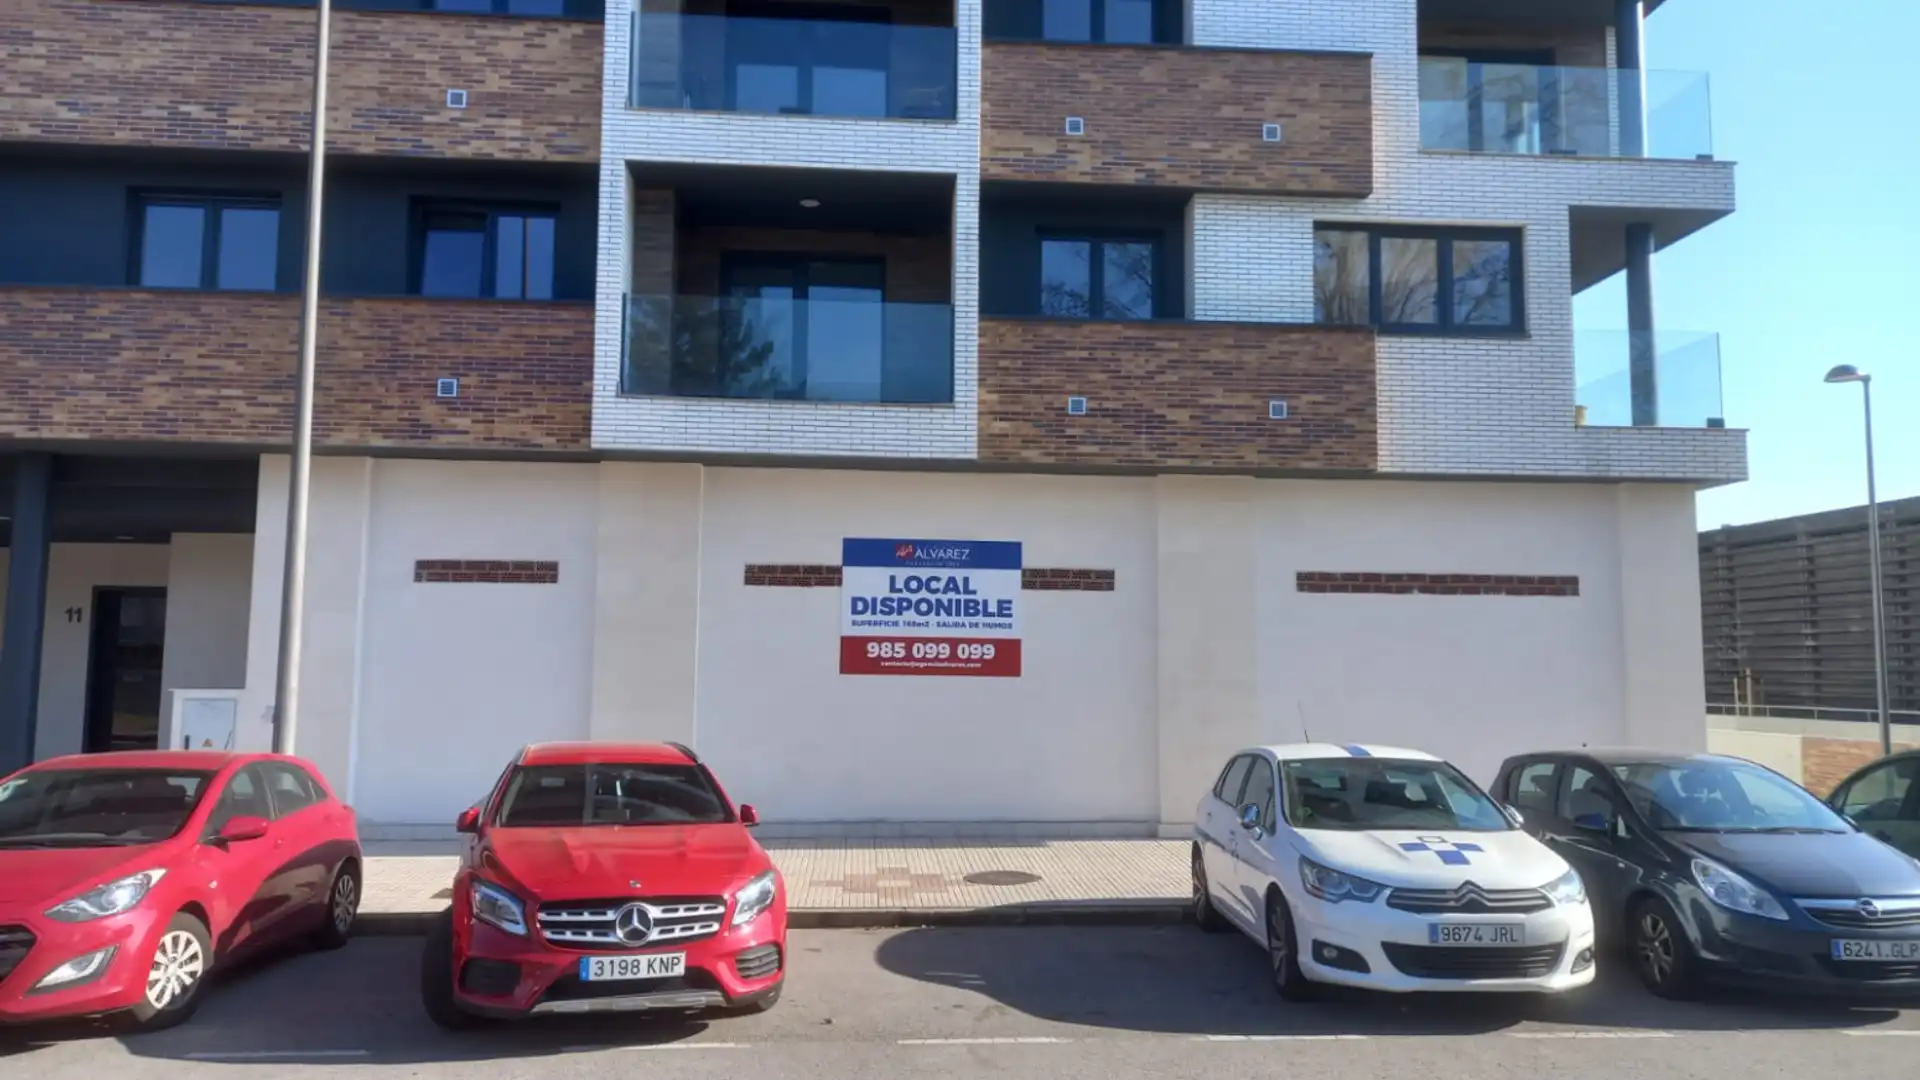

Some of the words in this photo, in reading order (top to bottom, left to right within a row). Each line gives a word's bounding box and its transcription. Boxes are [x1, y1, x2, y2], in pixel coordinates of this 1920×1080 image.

[889, 575, 977, 595] LOCAL
[64, 606, 82, 624] 11
[851, 597, 1013, 618] DISPONIBLE
[851, 619, 899, 628] SUPERFICIE
[936, 620, 967, 629] SALIDA
[969, 621, 979, 630] DE
[982, 622, 1013, 631] HUMOS
[867, 642, 907, 658] 985
[912, 643, 950, 659] 099
[957, 643, 995, 660] 099
[1441, 926, 1483, 942] 9674
[1489, 927, 1519, 942] JRL
[1843, 942, 1882, 957] 6241
[1891, 943, 1919, 958] GLP
[594, 959, 640, 977] 3198
[647, 956, 681, 974] KNP
